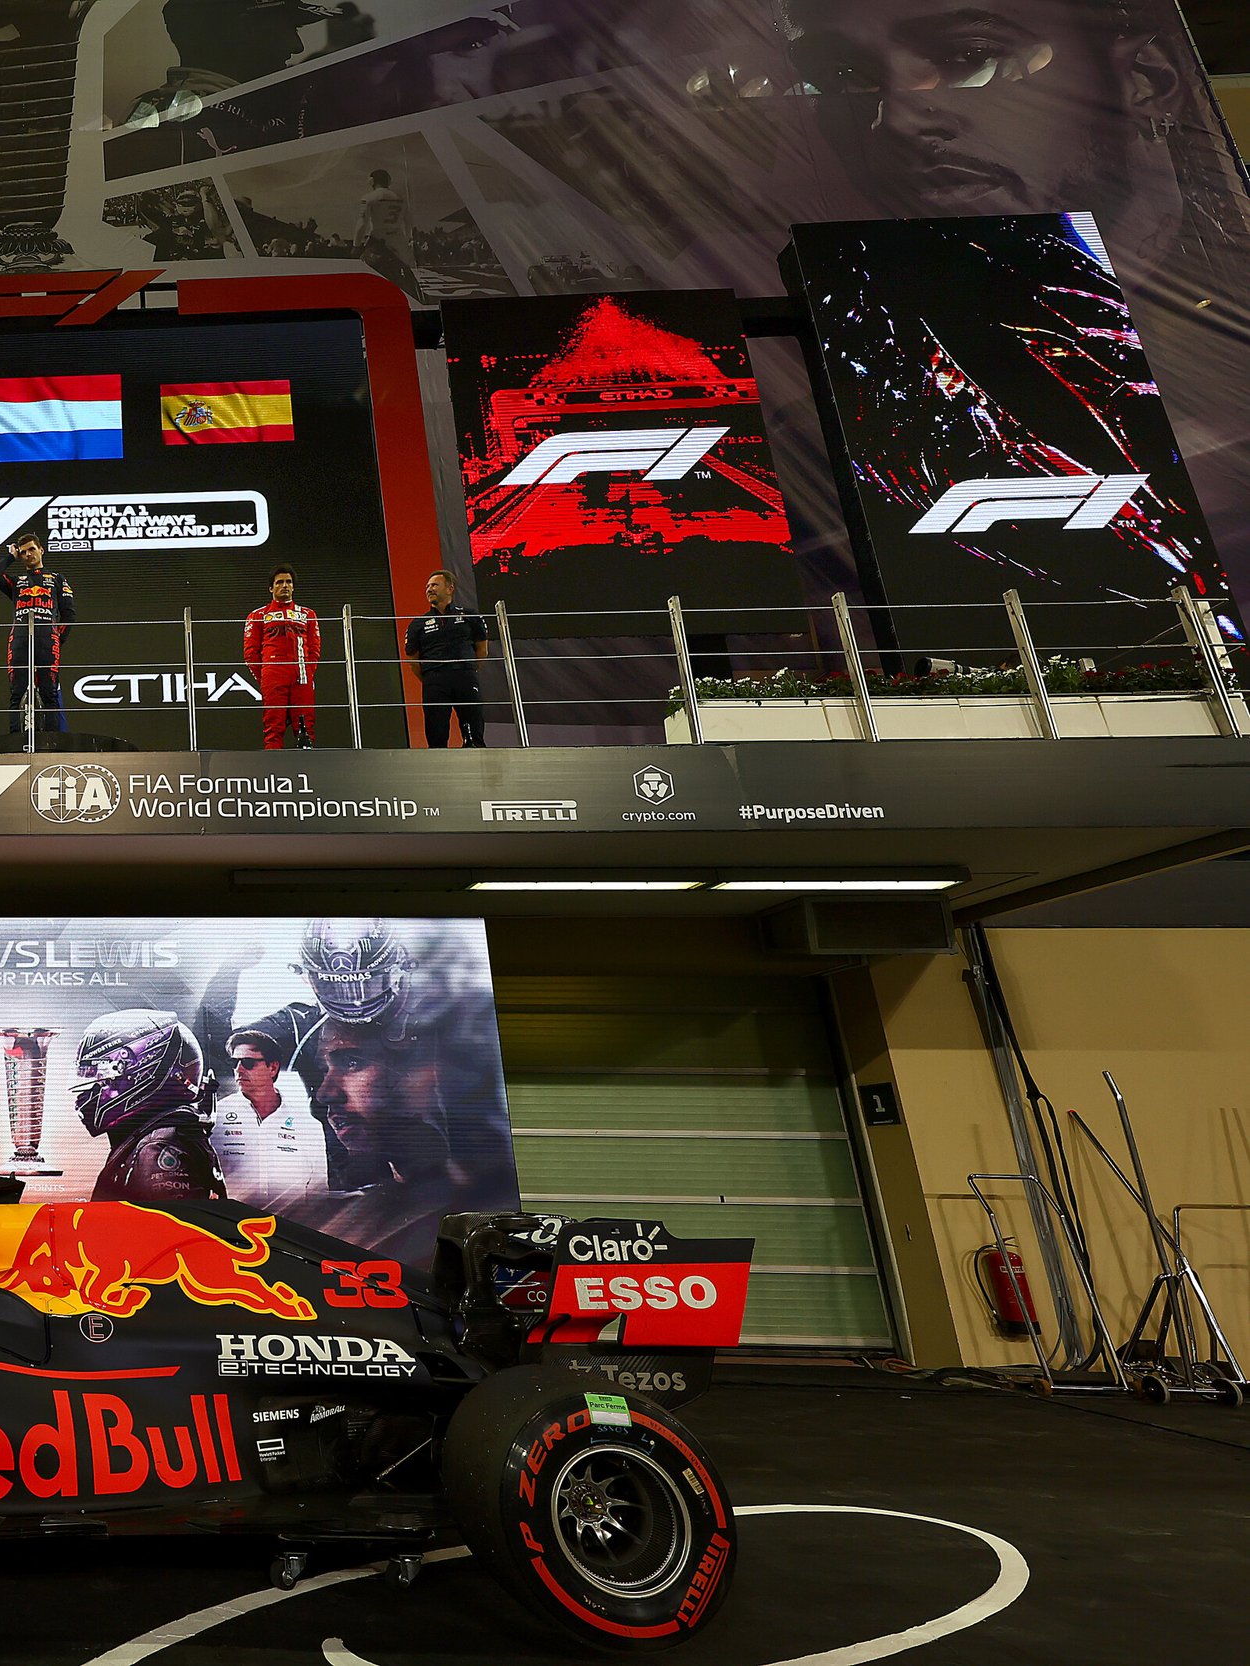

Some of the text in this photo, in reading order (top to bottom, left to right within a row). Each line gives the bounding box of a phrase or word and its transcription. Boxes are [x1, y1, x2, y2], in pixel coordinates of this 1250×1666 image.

[599, 388, 674, 401] ETIHAD
[47, 504, 149, 519] FORMULA 1
[47, 514, 196, 530] ETIHAD AIRWAYS
[48, 523, 256, 540] ABU DHABI GRAND PRIX
[48, 540, 92, 552] 2021
[15, 607, 52, 617] HONDA
[16, 597, 34, 609] Red
[73, 672, 263, 704] ETIHA
[130, 773, 314, 794] FIA Formula 1
[129, 797, 211, 818] World
[217, 796, 418, 821] Championship
[481, 801, 578, 821] PIRELLI
[622, 810, 696, 823] crypto.com
[738, 803, 885, 824] #PurposeDriven
[20, 971, 85, 986] TAKES
[89, 971, 128, 986] ALL
[317, 971, 372, 983] PETRONAS
[872, 1094, 886, 1113] 1
[569, 1234, 653, 1262] Claro
[320, 1260, 409, 1309] 33
[574, 1275, 718, 1311] ESSO
[215, 1334, 417, 1362] HONDA
[589, 1401, 605, 1409] Parc
[252, 1408, 300, 1423] SIEMENS
[82, 1392, 243, 1496] Bull
[519, 1409, 592, 1508] ZERO
[676, 1532, 731, 1629] PIRELLI
